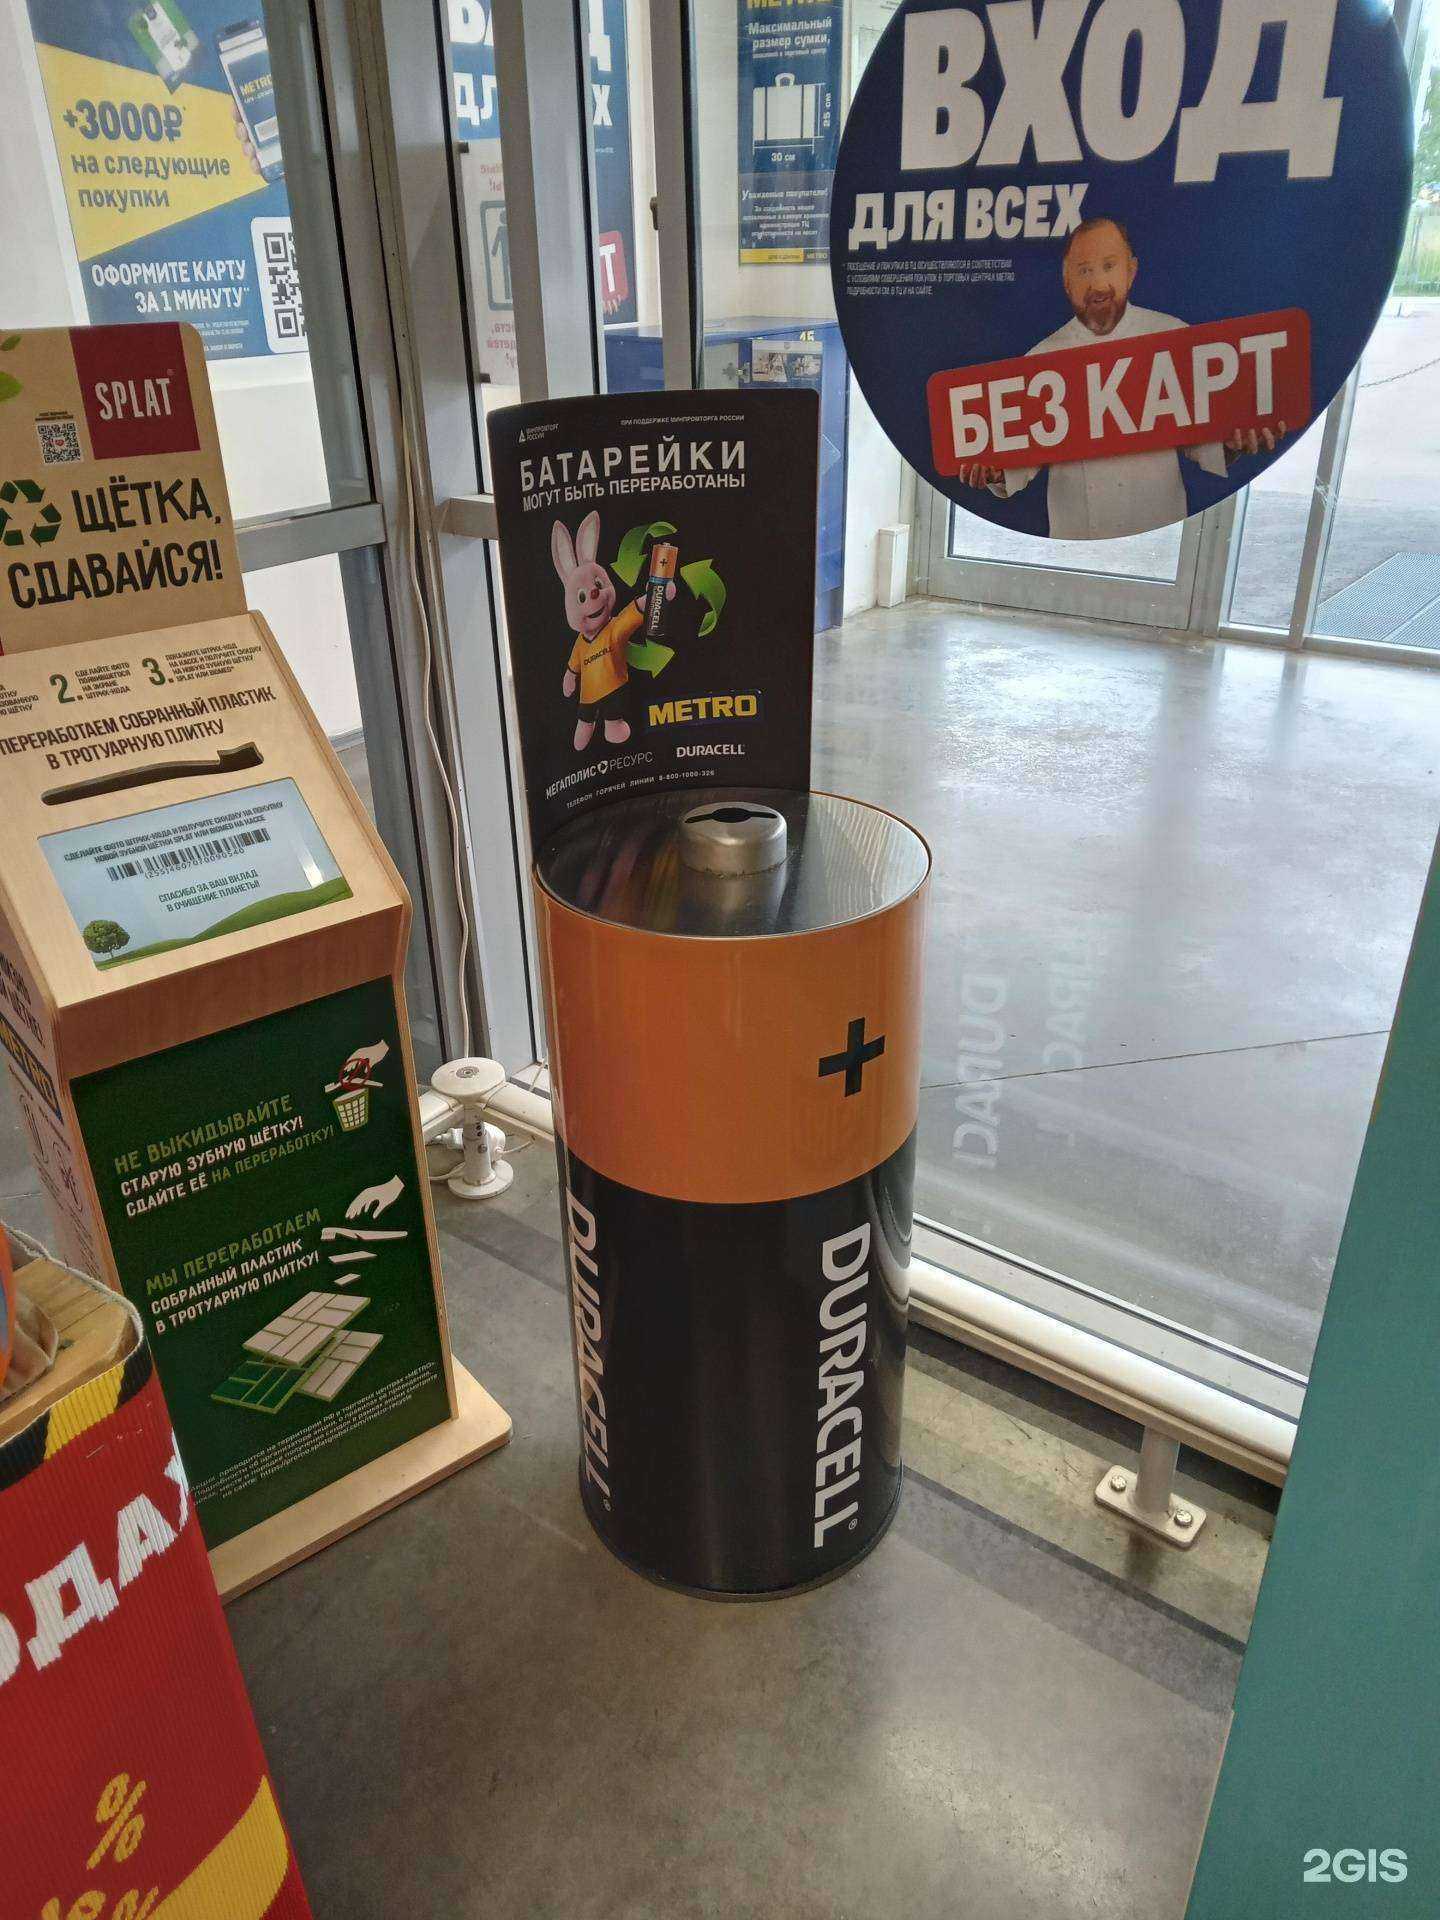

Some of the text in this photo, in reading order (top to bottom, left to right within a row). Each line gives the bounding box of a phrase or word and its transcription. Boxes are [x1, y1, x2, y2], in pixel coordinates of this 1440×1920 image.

[747, 17, 832, 35] Максимальный
[752, 37, 791, 53] размер
[900, 0, 1343, 183] ВХОД
[72, 154, 231, 180] на следующие
[78, 189, 170, 212] покупки
[848, 183, 1089, 250] ДЛЯ ВСЕХ
[91, 259, 246, 287] ОФОРМИТЕ КАРТУ
[136, 293, 160, 314] ЗА
[163, 291, 173, 313] 1
[95, 377, 173, 420] SPLAT
[948, 331, 1288, 459] БЕЗ КАРТ
[719, 414, 745, 422] РОССИИ
[520, 434, 745, 492] БАТАРЕЙКИ
[72, 475, 222, 533] ЩЁТКА,
[523, 473, 745, 512] МОГУТ БЫТЬ ПЕРЕРАБОТАНЫ
[7, 539, 224, 609] СДАВАЙСЯ!
[651, 585, 664, 630] DURACELL
[75, 662, 130, 677] СДЕЛАЙТЕ ФОТО
[82, 684, 92, 692] НА
[85, 686, 131, 699] ШТРИХ-КОДА
[649, 694, 758, 727] METRO
[0, 686, 277, 755] ПЕРЕРАБОТАЕМ СОБРАННЫЙ ПЛАСТИК
[46, 719, 225, 770] В ТРОТУАРНУЮ ПЛИТКУ
[609, 752, 653, 771] РЕСУРС
[676, 744, 743, 758] DURACELL
[567, 793, 592, 808] ТЕЛЕФОН
[630, 776, 654, 787] ЛИНИИ
[64, 845, 103, 861] СДЕЛАЙТЕ
[104, 840, 124, 851] ФОТО
[125, 829, 172, 846] ШТРИХ-КОДА
[178, 819, 213, 832] ПОЛУЧИТЕ
[213, 812, 241, 824] СКИДКУ
[243, 809, 253, 817] НА
[253, 801, 283, 814] ПОКУПКУ
[94, 851, 119, 863] НОВОЙ
[119, 844, 147, 857] ЗУБНОЙ
[173, 835, 193, 845] SPLAT
[194, 829, 209, 838] ИЛИ
[234, 820, 244, 828] НА
[158, 869, 259, 903] СПАСИБО ЗА ВАШ ВКЛАД
[166, 903, 174, 912] В
[174, 891, 219, 911] ОЧИЩЕНИЕ
[114, 1094, 293, 1175] НЕ ВЫКИДЫВАЙТЕ
[120, 1115, 304, 1197] СТАРУЮ ЗУБНУЮ ЩЁТКУ!
[125, 1124, 336, 1217] СДАЙТЕ ЕЁ НА ПЕРЕРАБОТКУ!
[145, 1207, 322, 1296] МЫ ПЕРЕРАБОТАЕМ
[150, 1238, 303, 1315] СОБРАННЫЙ ПЛАСТИК
[155, 1250, 320, 1332] В ТРОТУАРНУЮ ПЛИТКУ!
[565, 1187, 612, 1500] DURACELL
[813, 1222, 871, 1549] DURACELL
